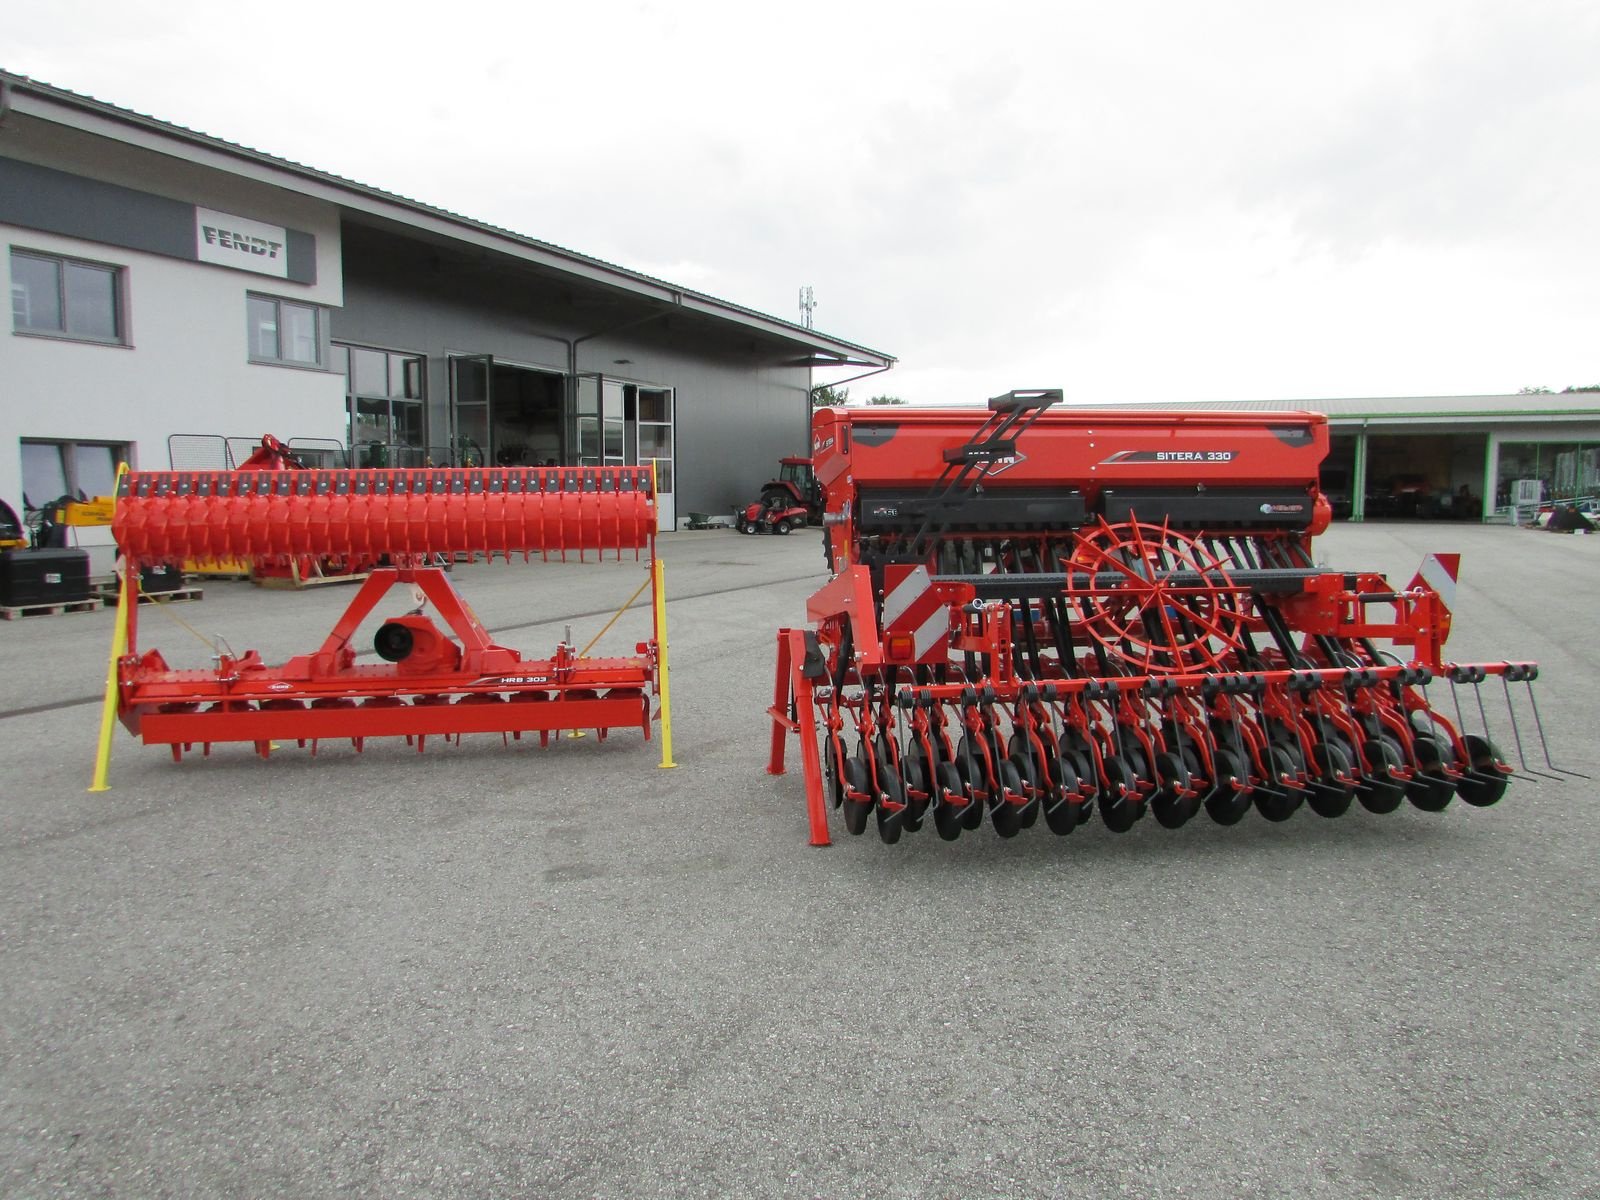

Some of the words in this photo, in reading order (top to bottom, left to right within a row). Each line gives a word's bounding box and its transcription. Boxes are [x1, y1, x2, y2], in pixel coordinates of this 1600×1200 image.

[202, 225, 283, 259] FENDT
[1156, 451, 1203, 461] SITERA
[1207, 451, 1231, 461] 330
